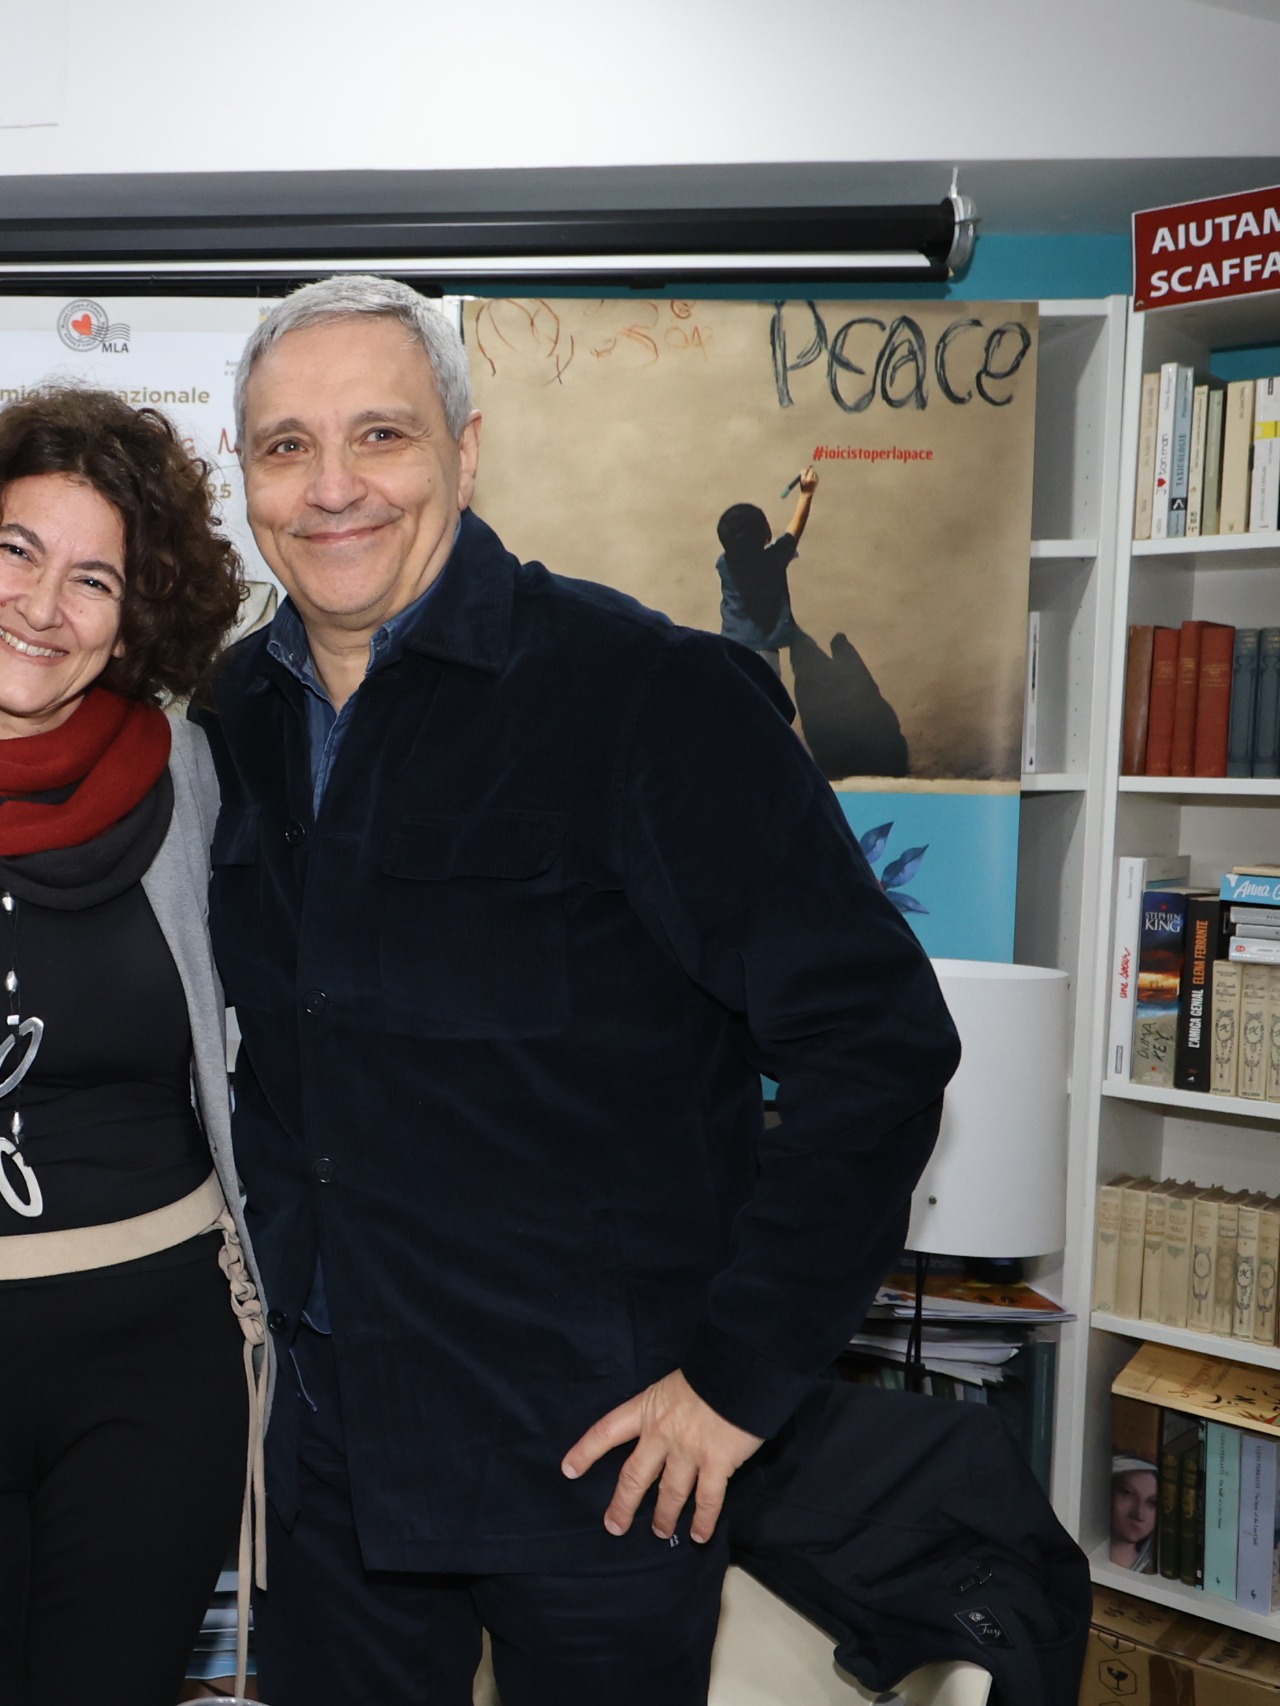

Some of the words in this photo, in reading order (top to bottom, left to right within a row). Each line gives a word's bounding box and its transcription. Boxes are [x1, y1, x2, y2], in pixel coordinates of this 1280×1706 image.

[101, 342, 129, 353] MLA
[812, 445, 934, 464] #ioicistoperlapace
[1232, 880, 1271, 899] Anna
[1144, 911, 1182, 922] STEPHEN
[1144, 918, 1181, 933] KING
[1194, 920, 1209, 959] FERRANTE
[1192, 961, 1206, 985] ELENA
[1190, 988, 1204, 1017] GENIAL
[1188, 1017, 1202, 1049] L'AMIGA
[1152, 1030, 1171, 1062] KEY
